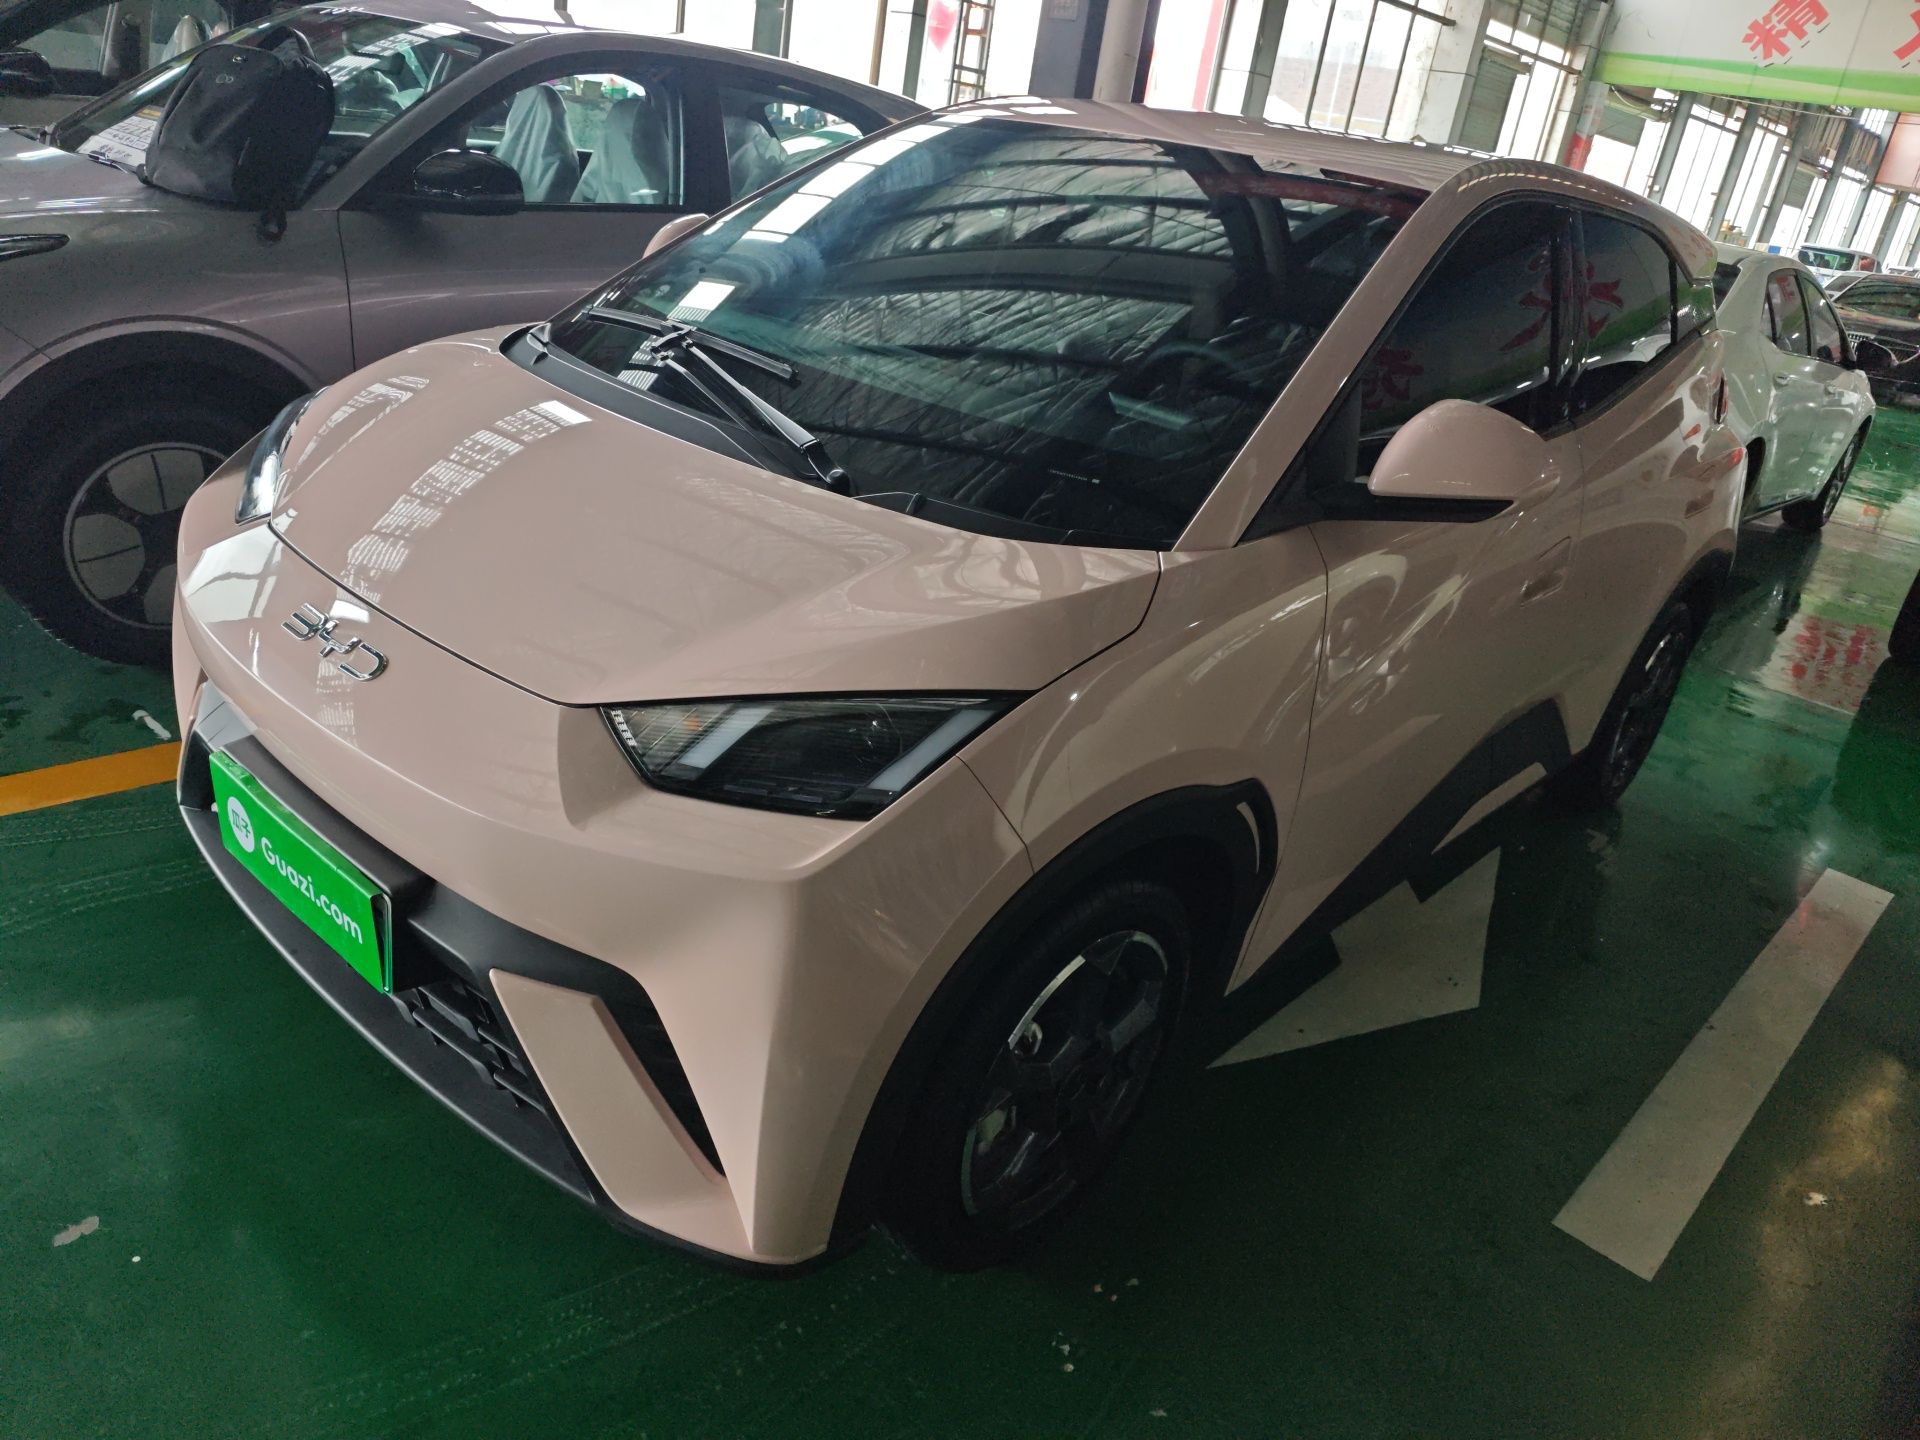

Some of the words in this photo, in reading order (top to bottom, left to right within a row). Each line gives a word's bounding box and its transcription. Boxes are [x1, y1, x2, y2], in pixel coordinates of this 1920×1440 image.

[281, 603, 389, 681] BYD
[231, 808, 251, 839] 瓜子
[261, 837, 363, 944] Guazi.com
